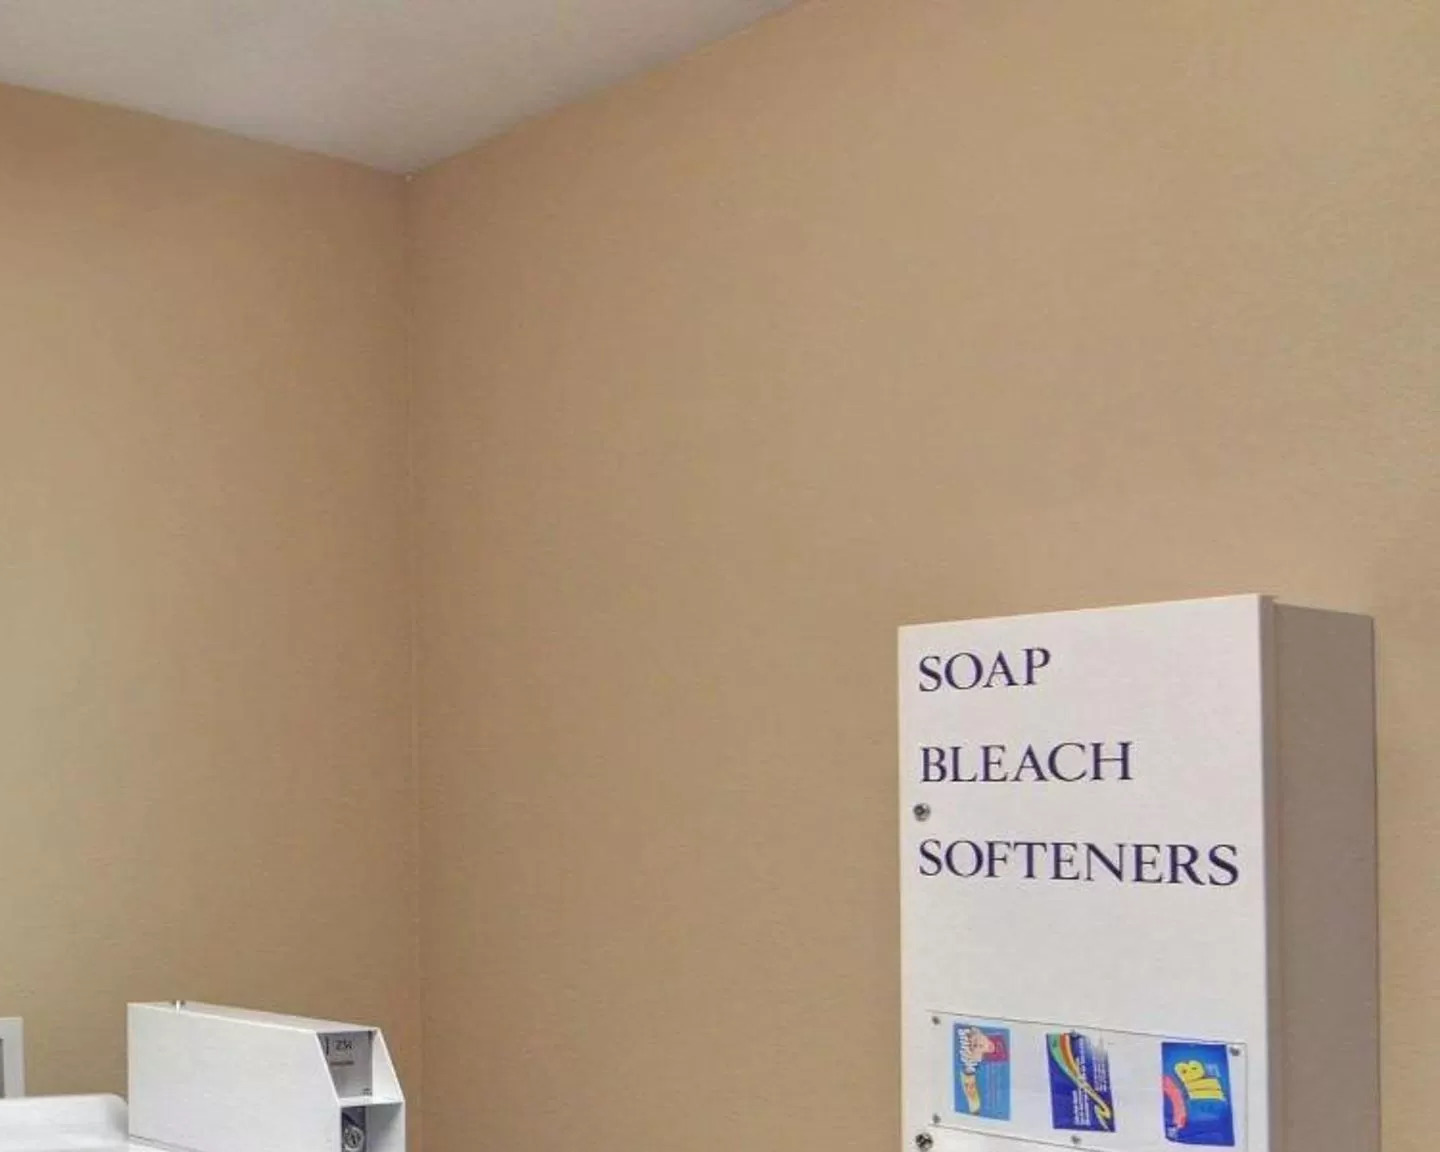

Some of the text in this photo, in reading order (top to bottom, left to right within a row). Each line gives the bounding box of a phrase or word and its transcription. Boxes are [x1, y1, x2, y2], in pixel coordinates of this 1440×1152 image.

[918, 646, 1051, 693] SOAP
[920, 740, 1134, 784] BLEACH
[918, 838, 1240, 887] SOFTENERS
